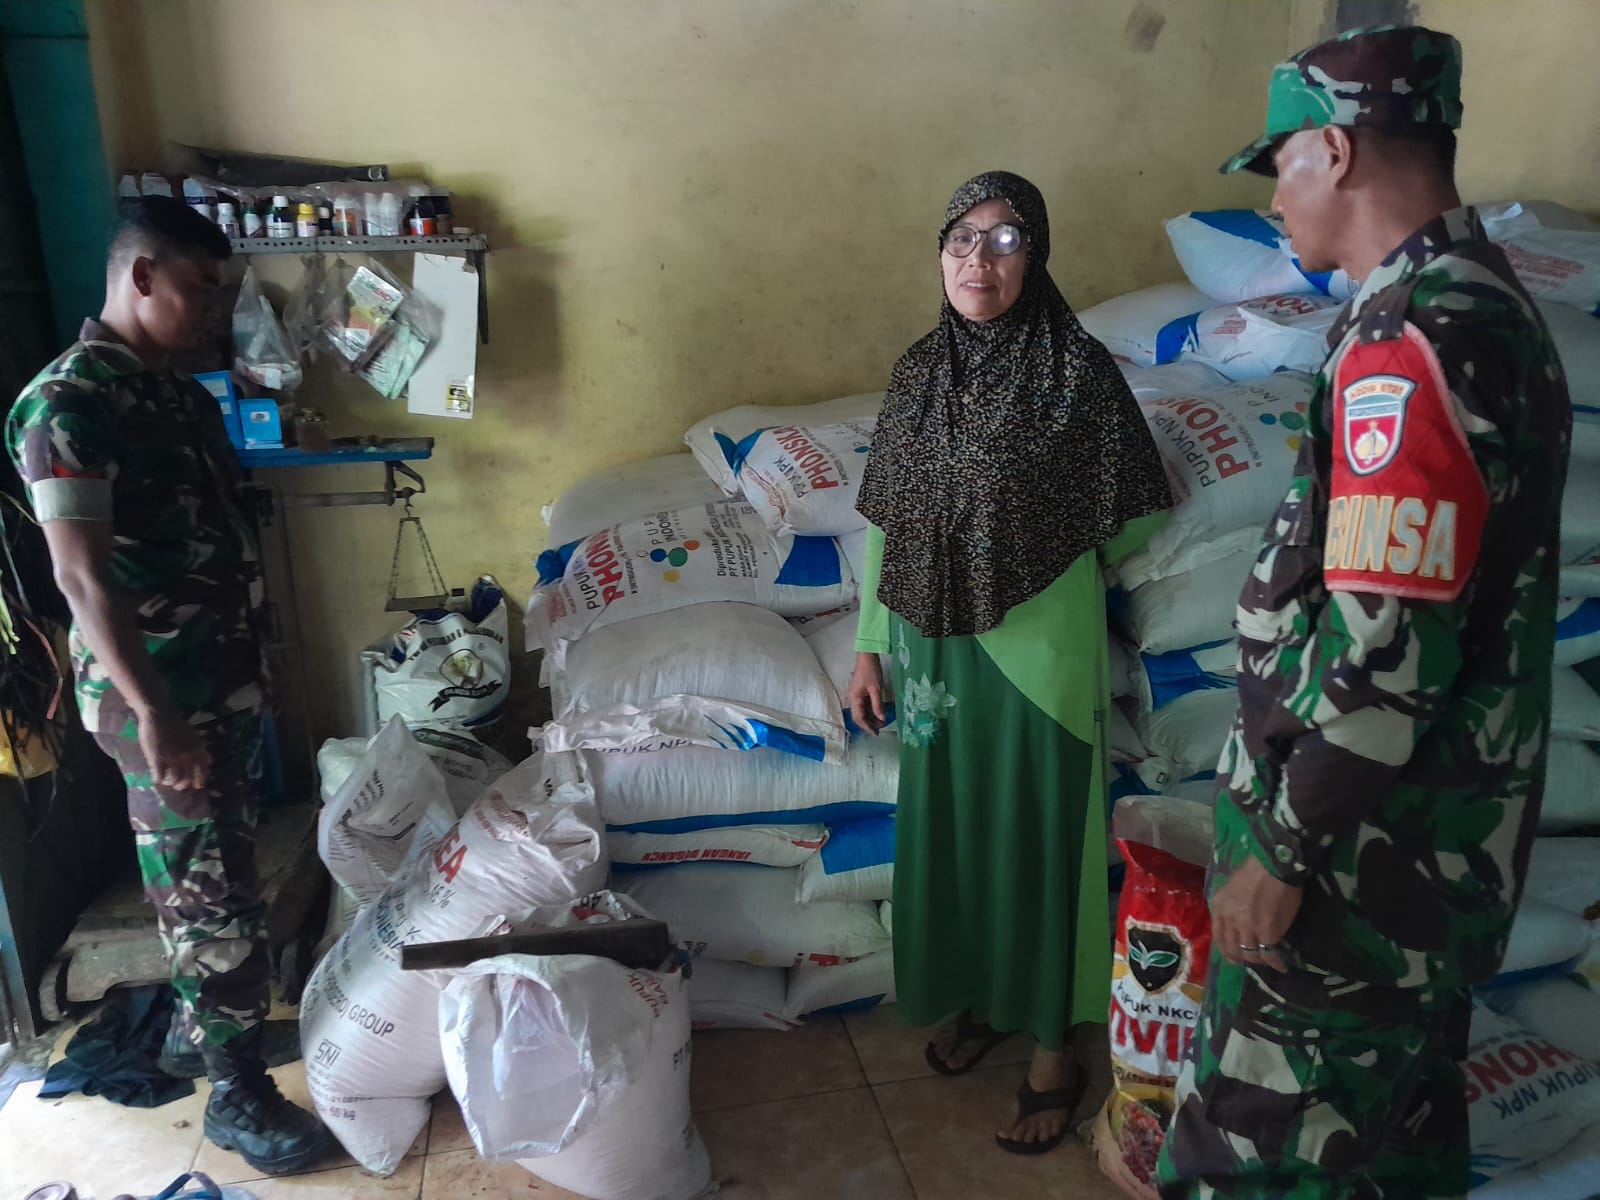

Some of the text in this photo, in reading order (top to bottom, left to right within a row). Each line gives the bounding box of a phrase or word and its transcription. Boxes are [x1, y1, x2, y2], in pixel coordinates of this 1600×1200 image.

[773, 426, 839, 489] PHONSKA
[1170, 430, 1217, 487] PUPUK
[350, 1004, 394, 1037] GROUP
[314, 1039, 342, 1068] SNI
[1491, 1083, 1539, 1119] NPK
